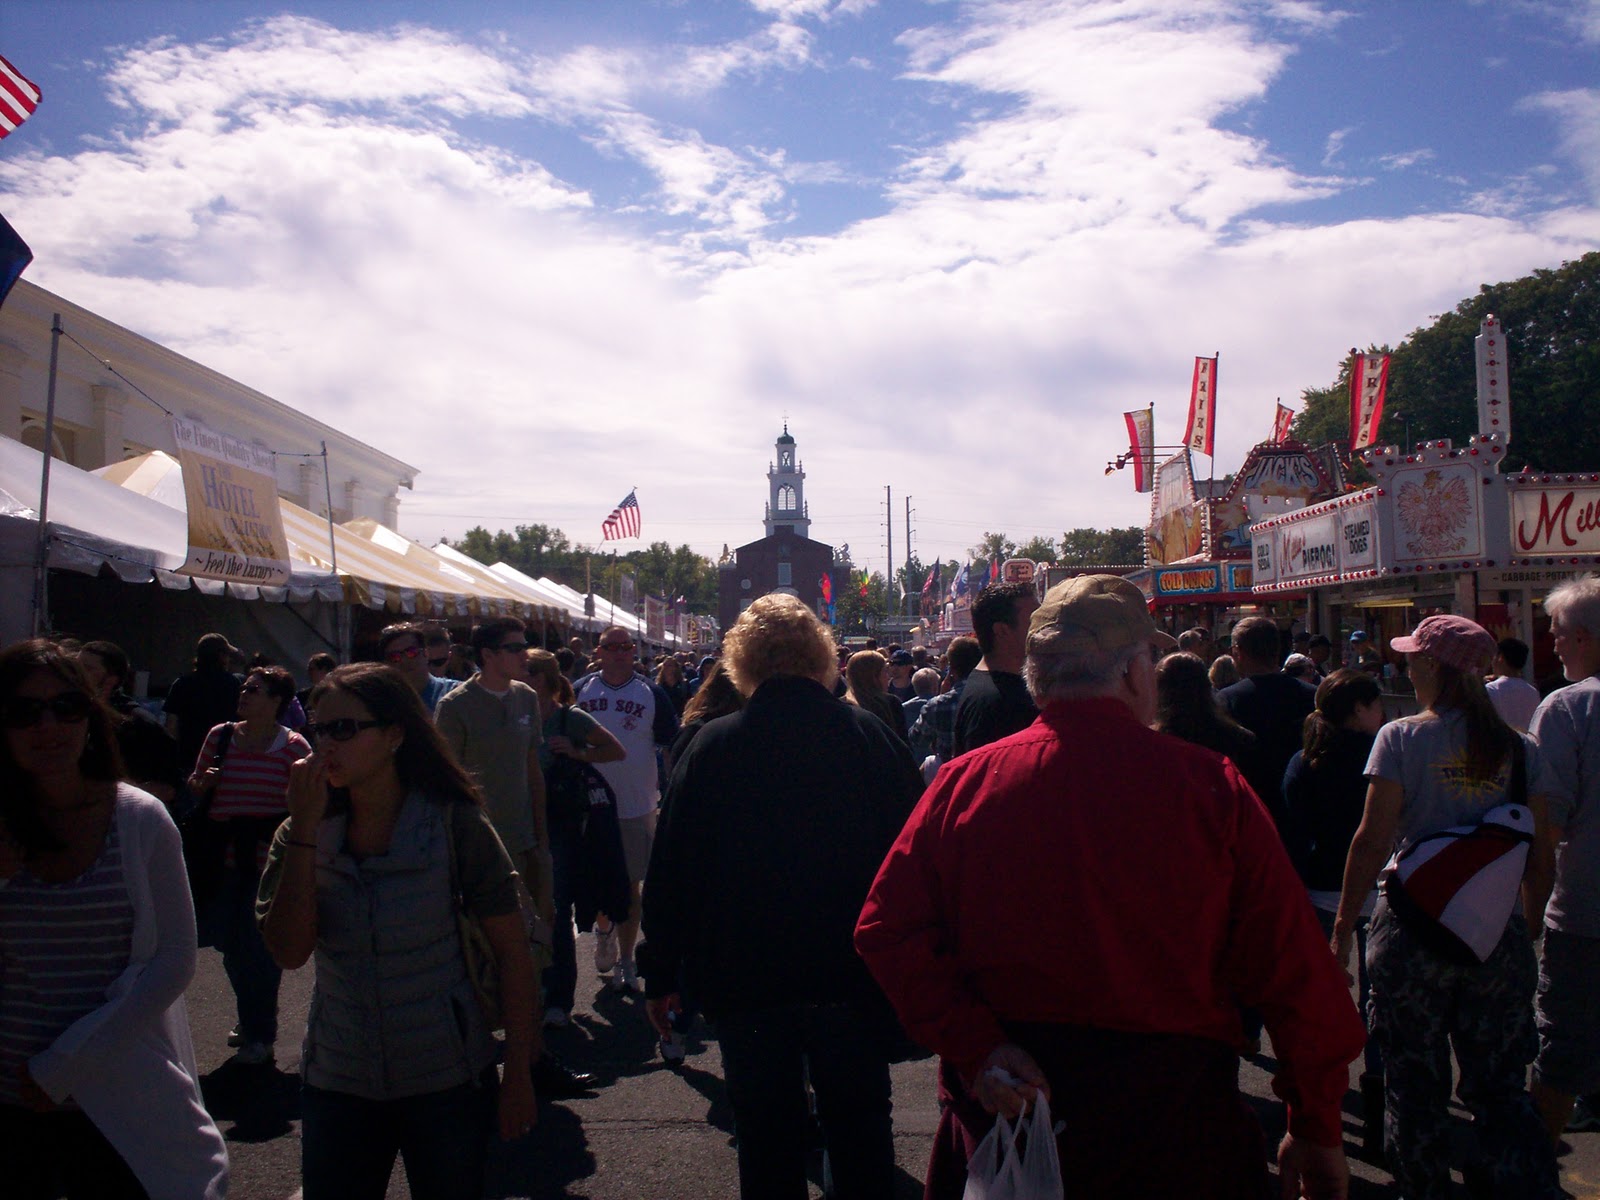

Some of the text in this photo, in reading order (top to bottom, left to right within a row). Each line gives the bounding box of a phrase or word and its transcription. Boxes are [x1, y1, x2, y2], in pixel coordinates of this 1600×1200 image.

[201, 463, 260, 519] HOTEL
[1344, 520, 1370, 541] STEAMED
[1302, 543, 1335, 570] PIEROGI
[1349, 537, 1368, 554] DOGS
[203, 552, 275, 584] Feel the Luxury
[1161, 571, 1181, 591] COLD
[1181, 568, 1216, 591] DRINKS
[580, 697, 645, 718] RED SOX
